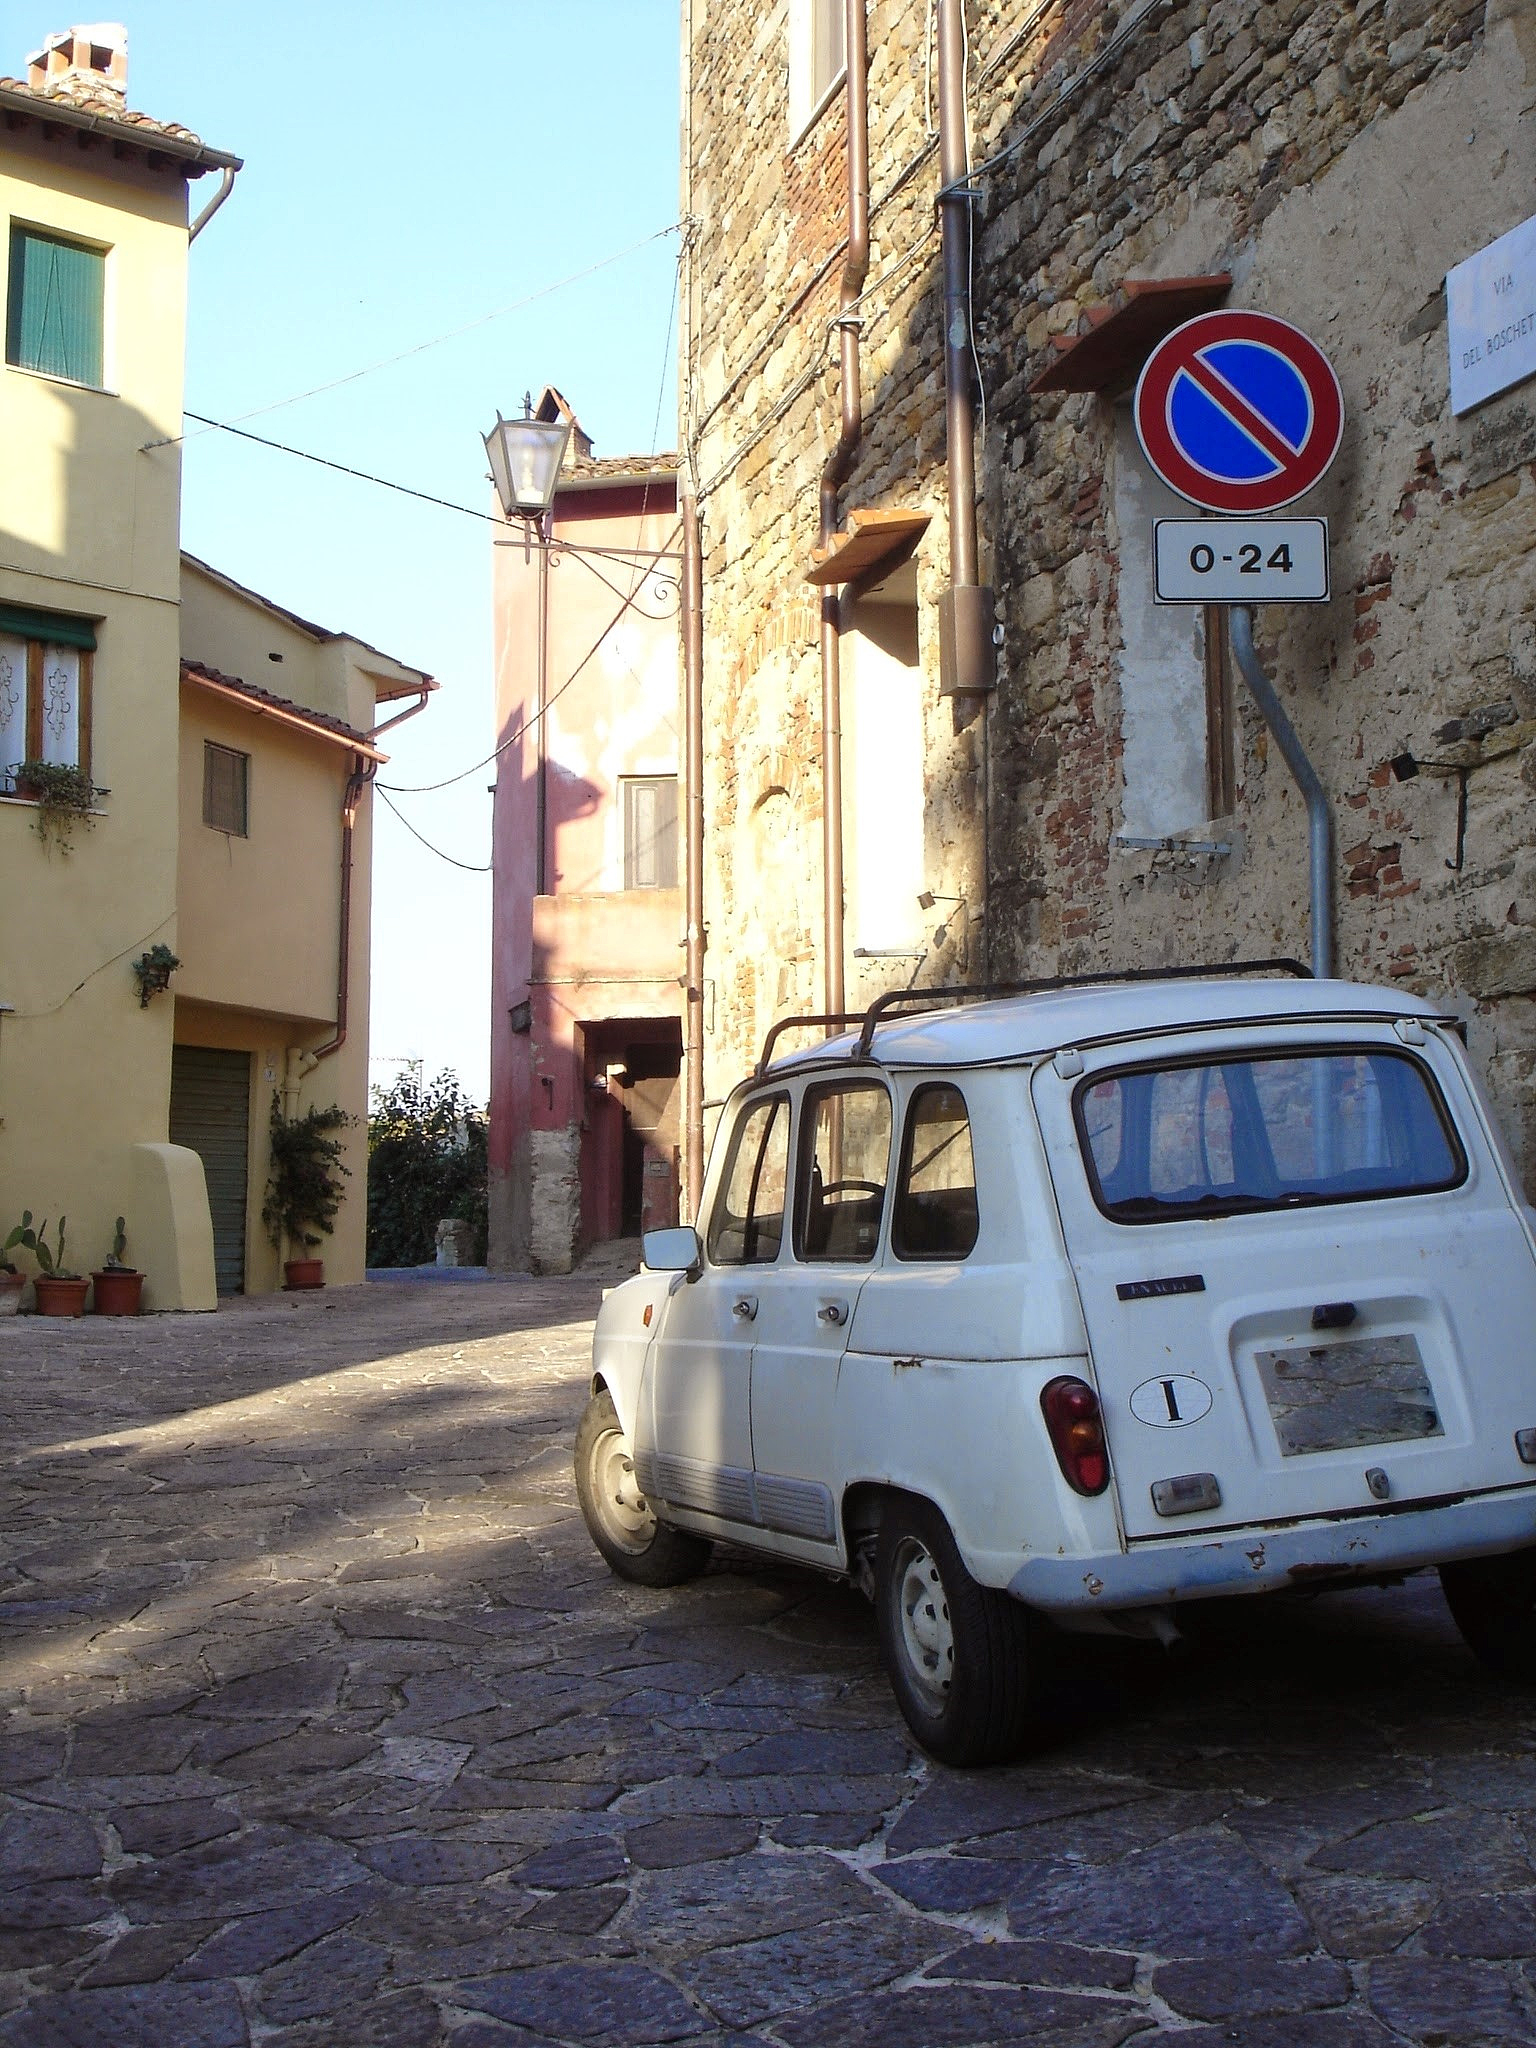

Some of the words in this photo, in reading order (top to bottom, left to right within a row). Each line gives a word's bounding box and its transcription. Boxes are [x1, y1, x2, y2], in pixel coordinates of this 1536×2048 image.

[1493, 274, 1513, 296] VIA
[1463, 346, 1482, 370] DEL
[1487, 312, 1536, 355] BOSCHET
[1160, 1380, 1183, 1421] I
